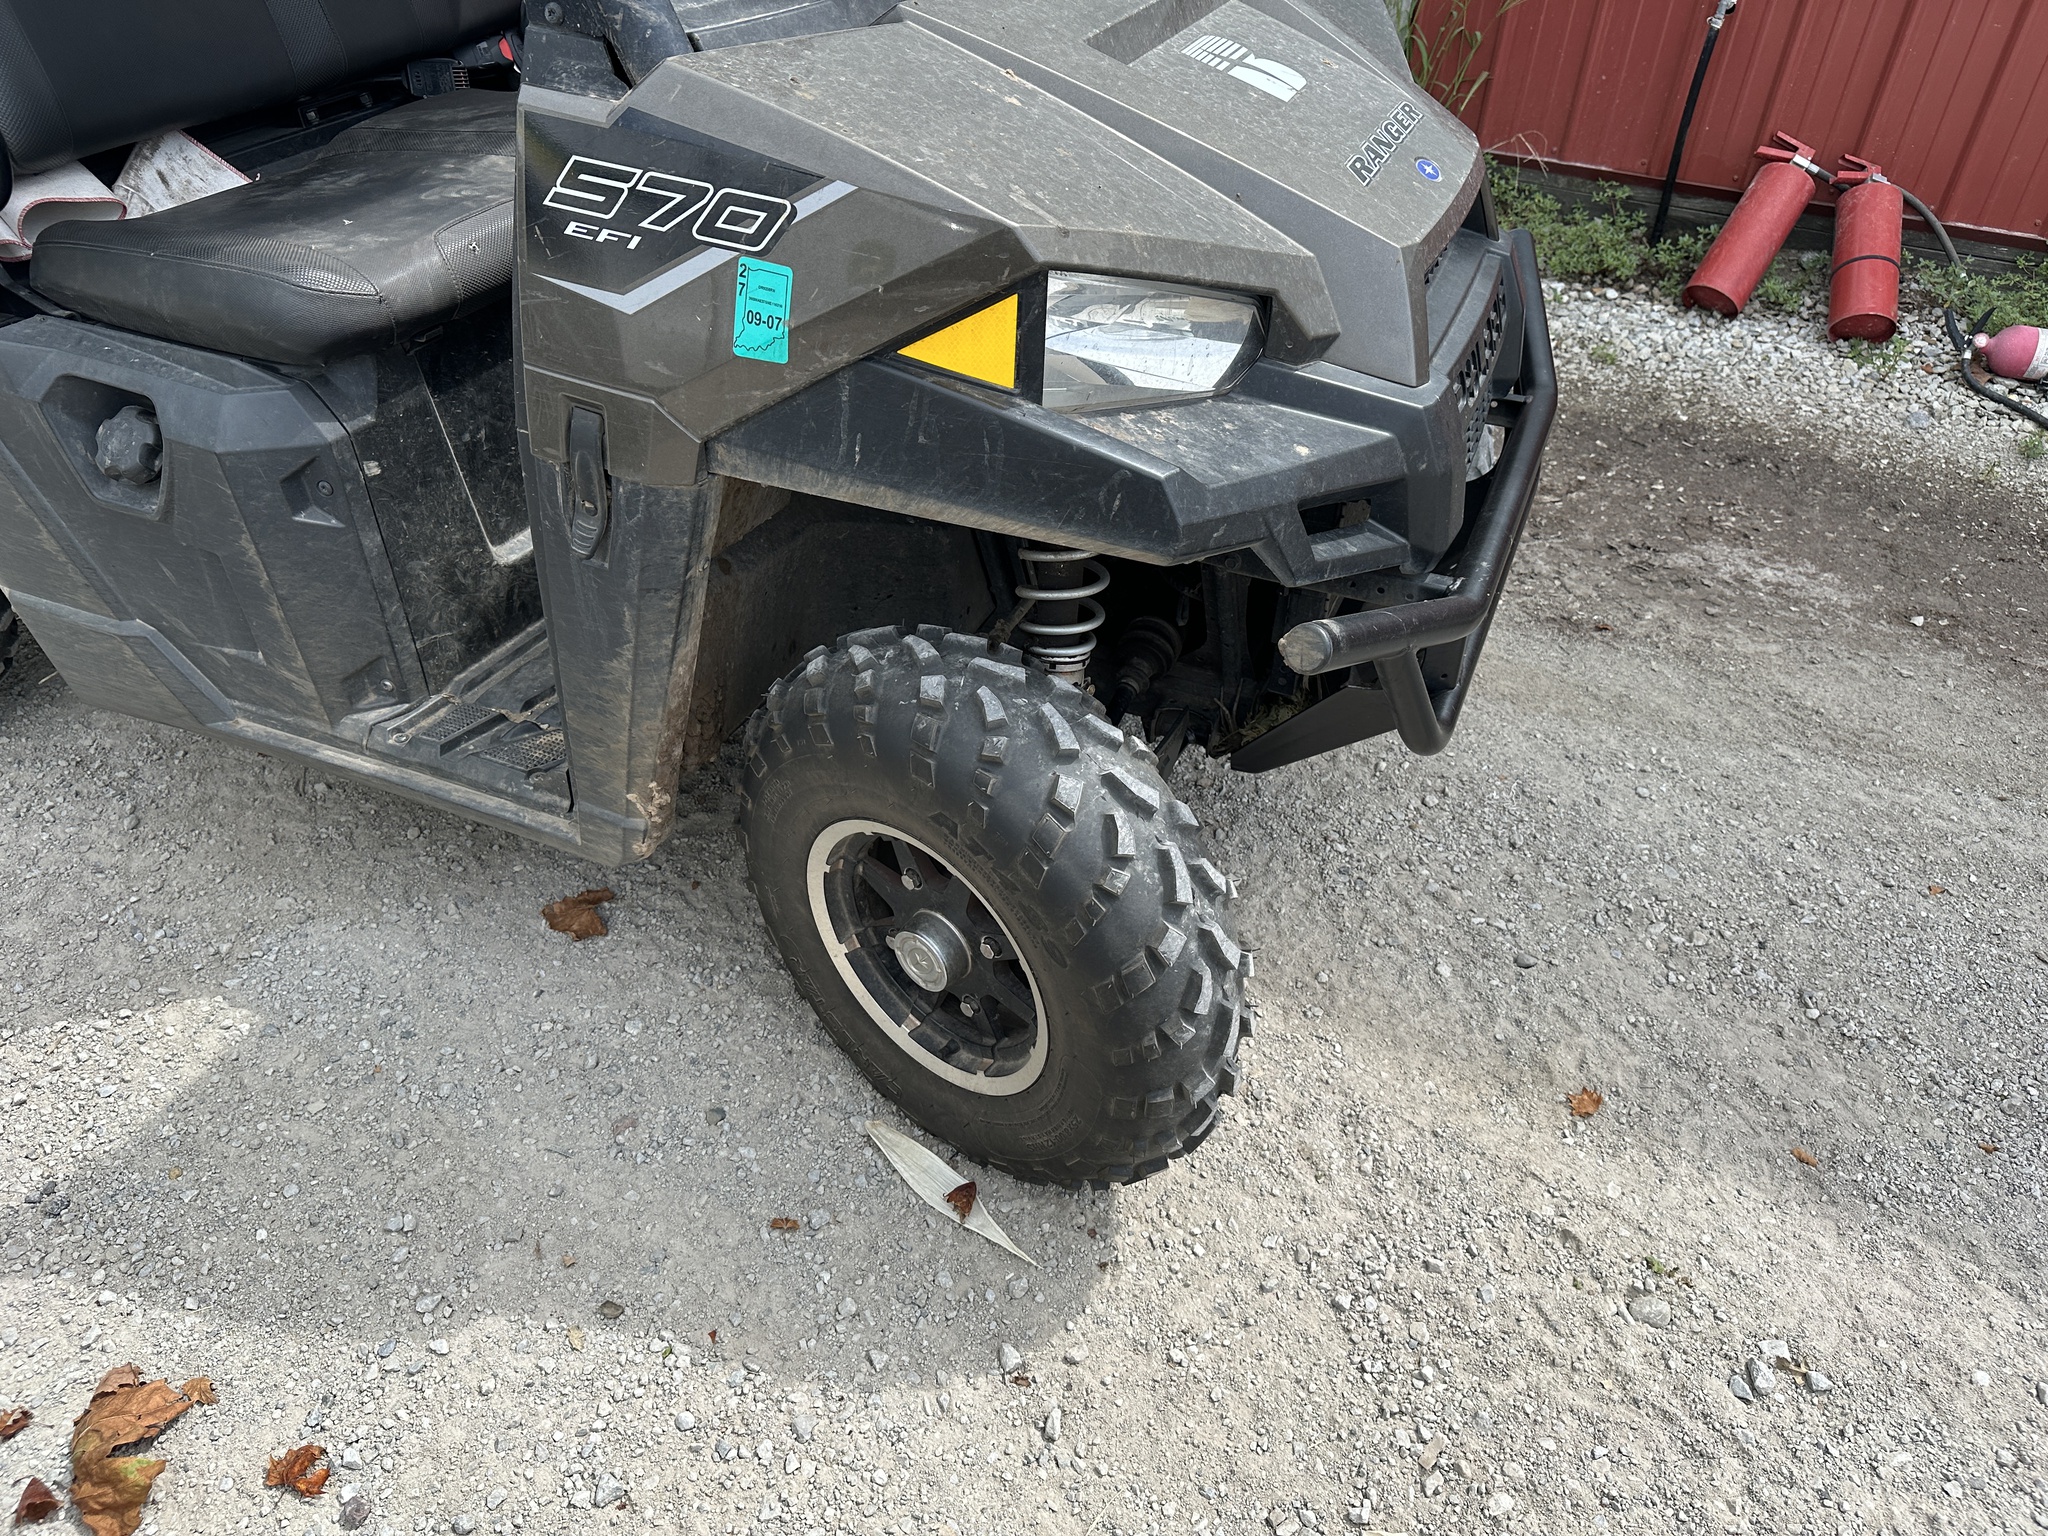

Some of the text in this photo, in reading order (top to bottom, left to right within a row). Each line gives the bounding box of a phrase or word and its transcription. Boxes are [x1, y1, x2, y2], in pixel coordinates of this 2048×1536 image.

[1345, 100, 1424, 187] RANGER
[542, 154, 794, 253] 570
[564, 220, 644, 250] EFI
[746, 309, 783, 331] 09-07
